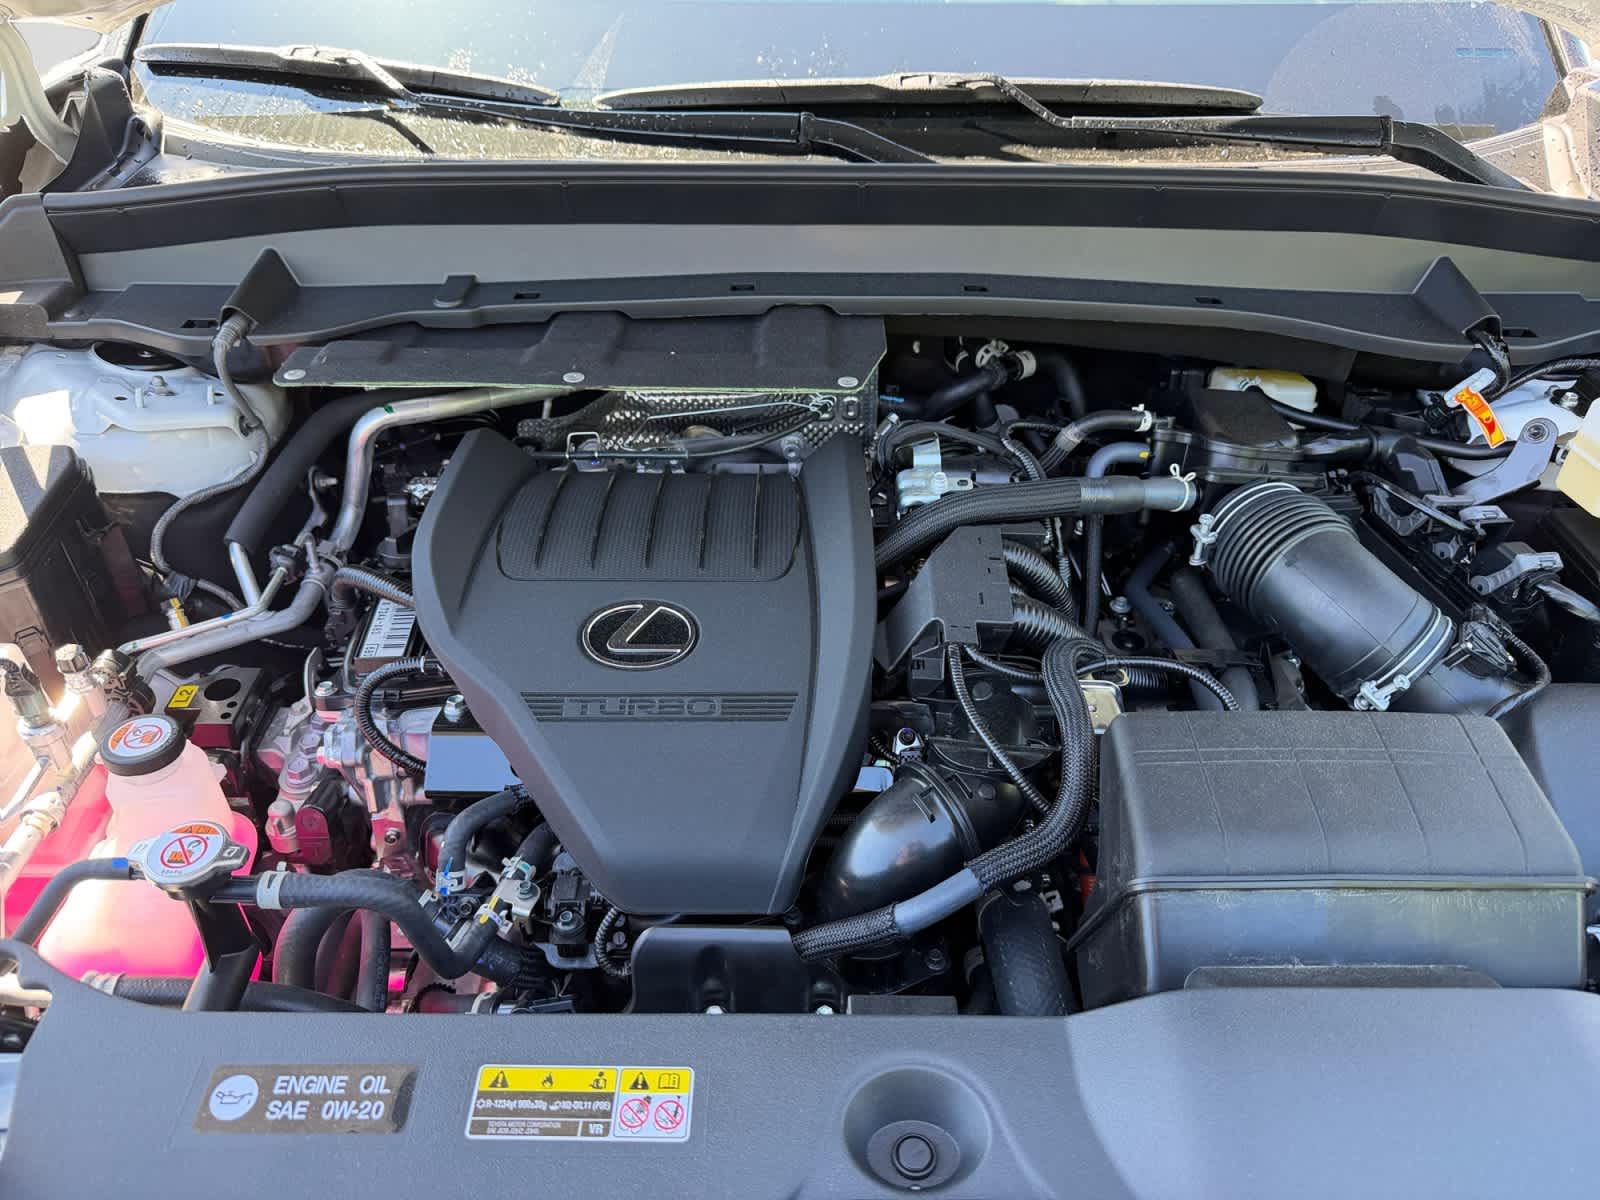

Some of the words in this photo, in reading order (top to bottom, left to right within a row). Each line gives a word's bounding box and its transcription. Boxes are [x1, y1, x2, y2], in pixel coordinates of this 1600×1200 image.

[175, 689, 194, 703] L2
[563, 696, 720, 717] TURBO
[273, 1075, 349, 1094] ENGINE
[359, 1075, 391, 1094] OIL
[265, 1100, 310, 1120] SAE
[321, 1100, 385, 1120] 0W-20
[588, 1123, 605, 1135] VR
